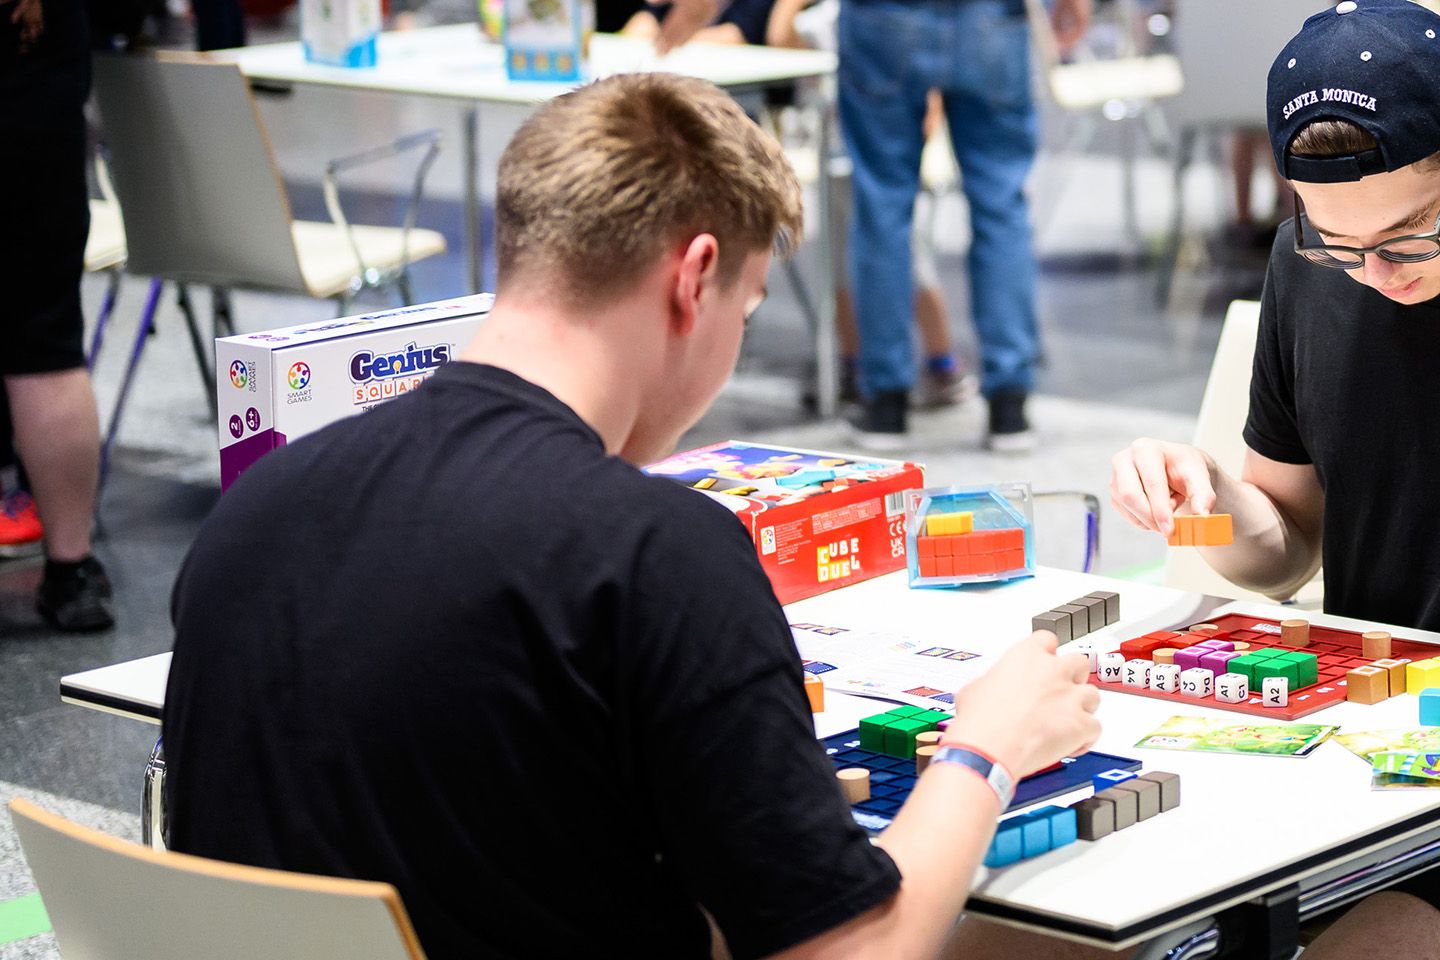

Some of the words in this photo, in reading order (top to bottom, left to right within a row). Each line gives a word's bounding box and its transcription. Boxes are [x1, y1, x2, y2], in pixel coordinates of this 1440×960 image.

[1283, 90, 1319, 120] SANTA
[1321, 88, 1377, 111] MONICA
[350, 343, 449, 382] Genius
[287, 389, 312, 398] SMART
[356, 378, 422, 400] SQUAR
[287, 395, 312, 405] GAMES
[230, 422, 238, 430] 2
[248, 411, 254, 428] 6+
[819, 537, 861, 564] CUBE
[819, 554, 861, 582] DUEL
[1105, 667, 1121, 677] A6
[1127, 668, 1136, 683] A4
[1156, 674, 1165, 690] A5
[1183, 680, 1196, 691] C4
[1203, 677, 1211, 693] D4
[1220, 685, 1229, 698] A1
[1238, 684, 1245, 699] C1
[1270, 688, 1280, 703] A2
